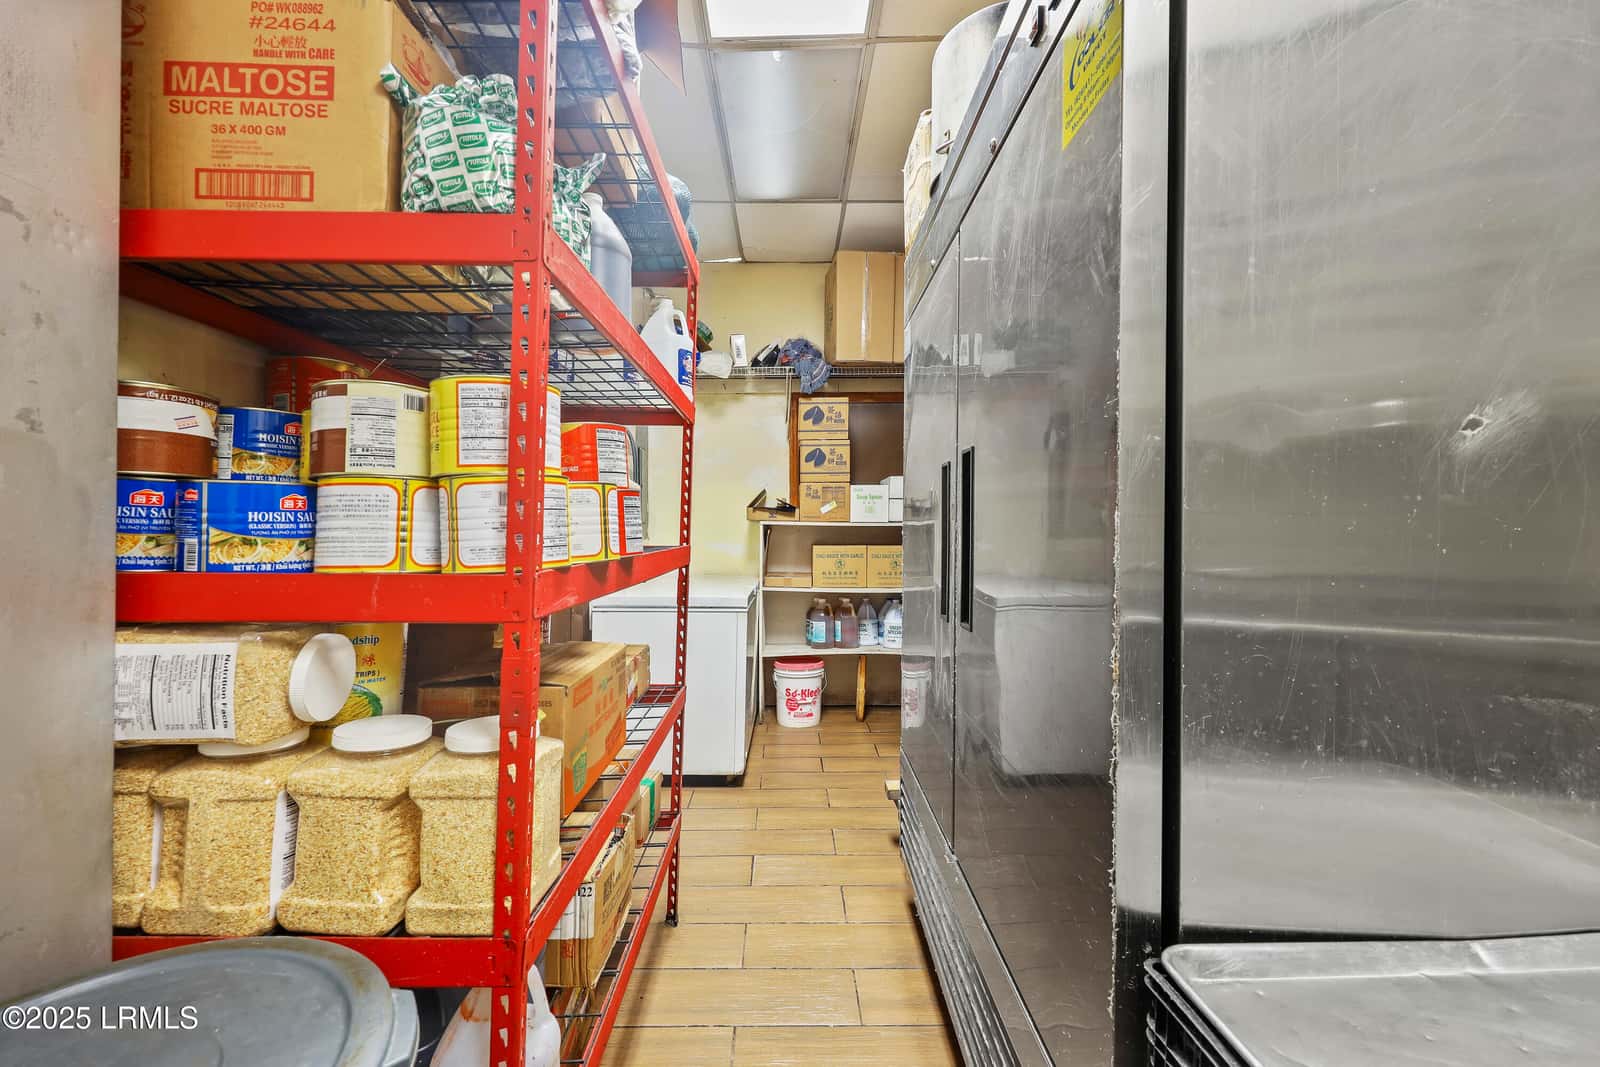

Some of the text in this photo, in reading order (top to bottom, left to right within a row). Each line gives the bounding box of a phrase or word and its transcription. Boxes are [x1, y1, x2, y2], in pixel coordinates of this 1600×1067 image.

[251, 1, 273, 13] PO#
[248, 15, 336, 32] #24644
[253, 47, 335, 60] HANDLE WITH CARE
[171, 65, 329, 96] MALTOSE
[168, 99, 328, 118] SUCRE MALTOSE
[210, 124, 227, 135] 36
[239, 125, 262, 136] 400
[264, 125, 286, 136] GM
[259, 432, 297, 445] HOISIN
[117, 506, 176, 519] ISIN SAU
[248, 511, 315, 522] HOISIN SAU
[352, 635, 380, 646] dship
[356, 670, 376, 678] TRIPS
[221, 653, 231, 729] Nutrition Facts
